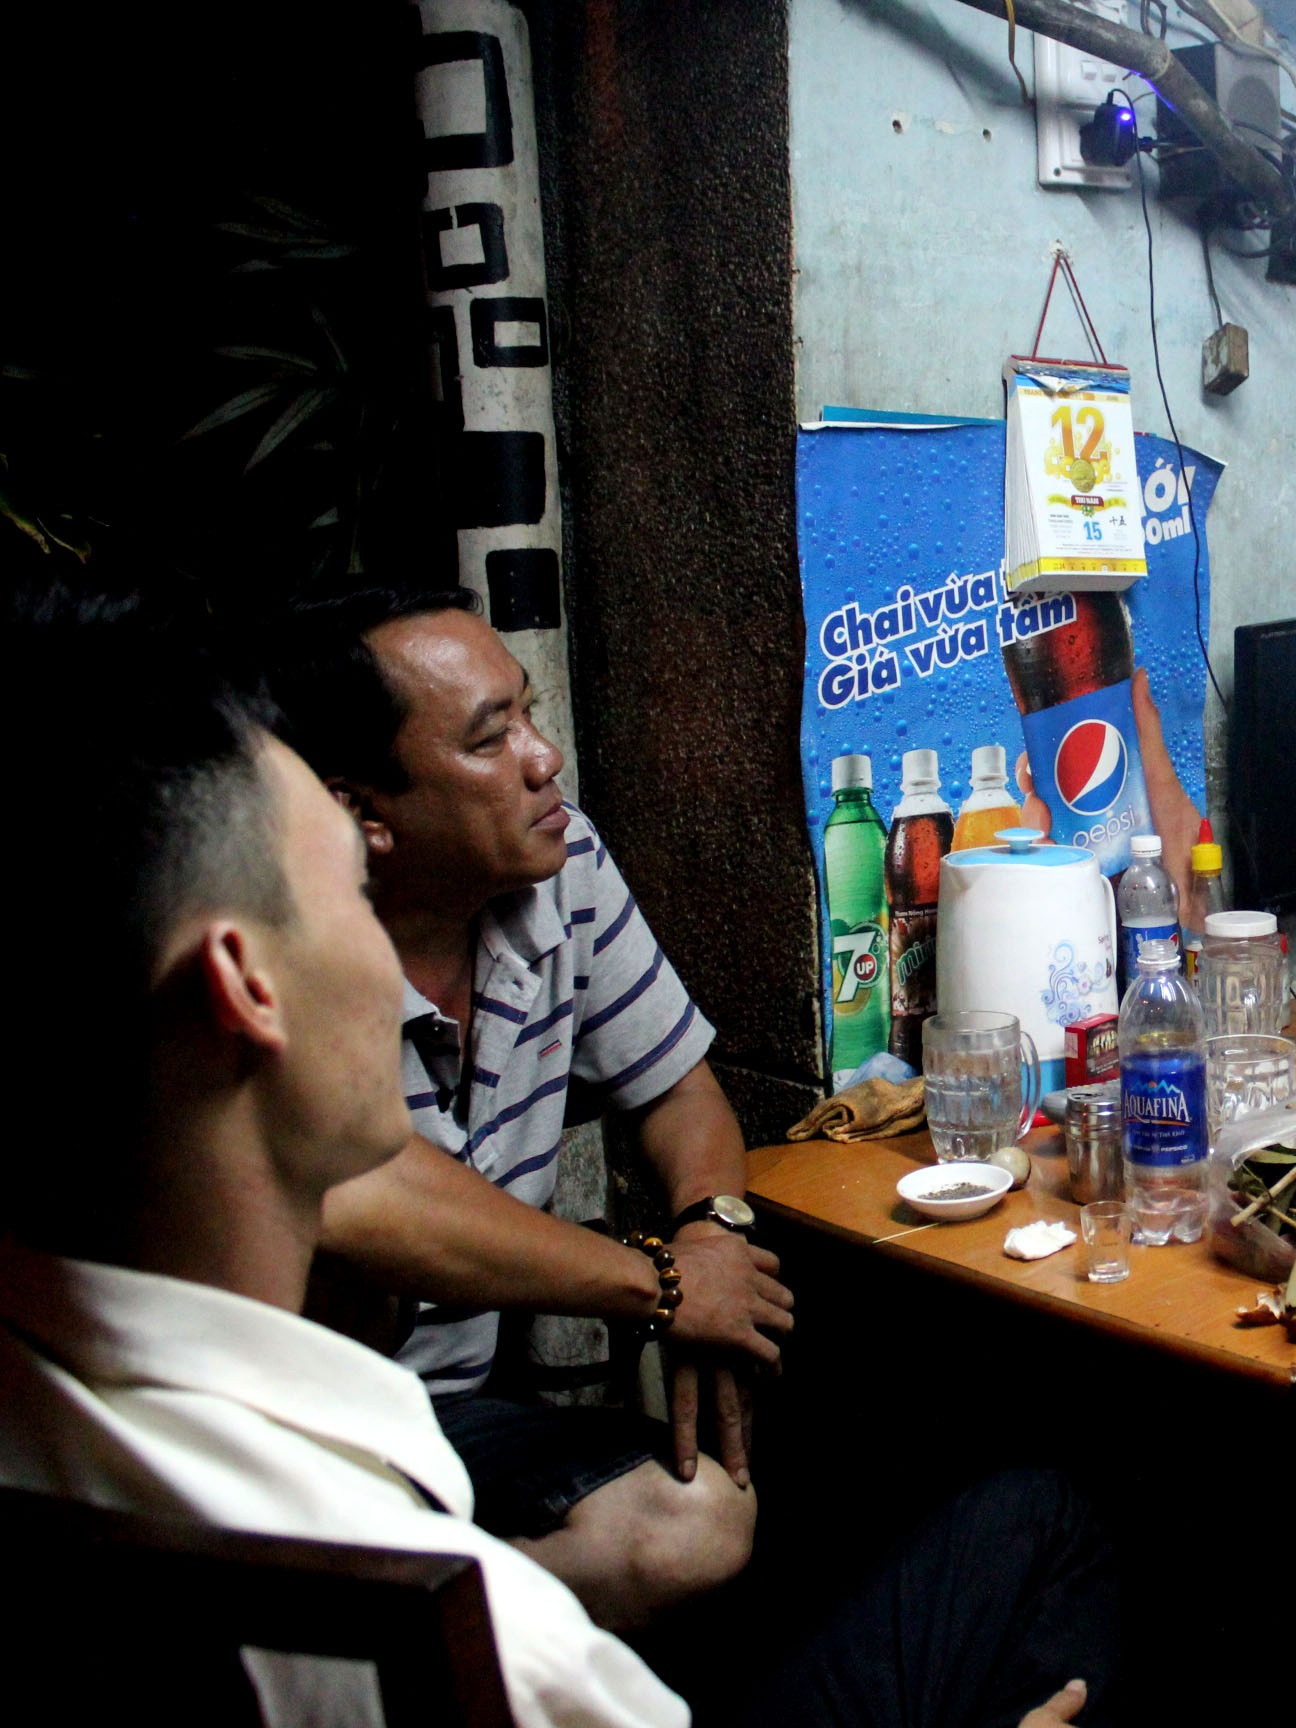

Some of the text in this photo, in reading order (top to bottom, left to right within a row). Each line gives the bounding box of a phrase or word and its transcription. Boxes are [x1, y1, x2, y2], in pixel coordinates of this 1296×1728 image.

[1051, 405, 1108, 463] 12
[1083, 521, 1103, 541] 15
[1142, 504, 1192, 545] 0ml
[820, 585, 916, 661] Chai
[914, 571, 997, 628] vừa
[818, 645, 901, 709] Giá
[904, 620, 988, 678] vừa
[1073, 804, 1136, 848] pepsi
[1124, 1089, 1191, 1124] AQUAFINA
